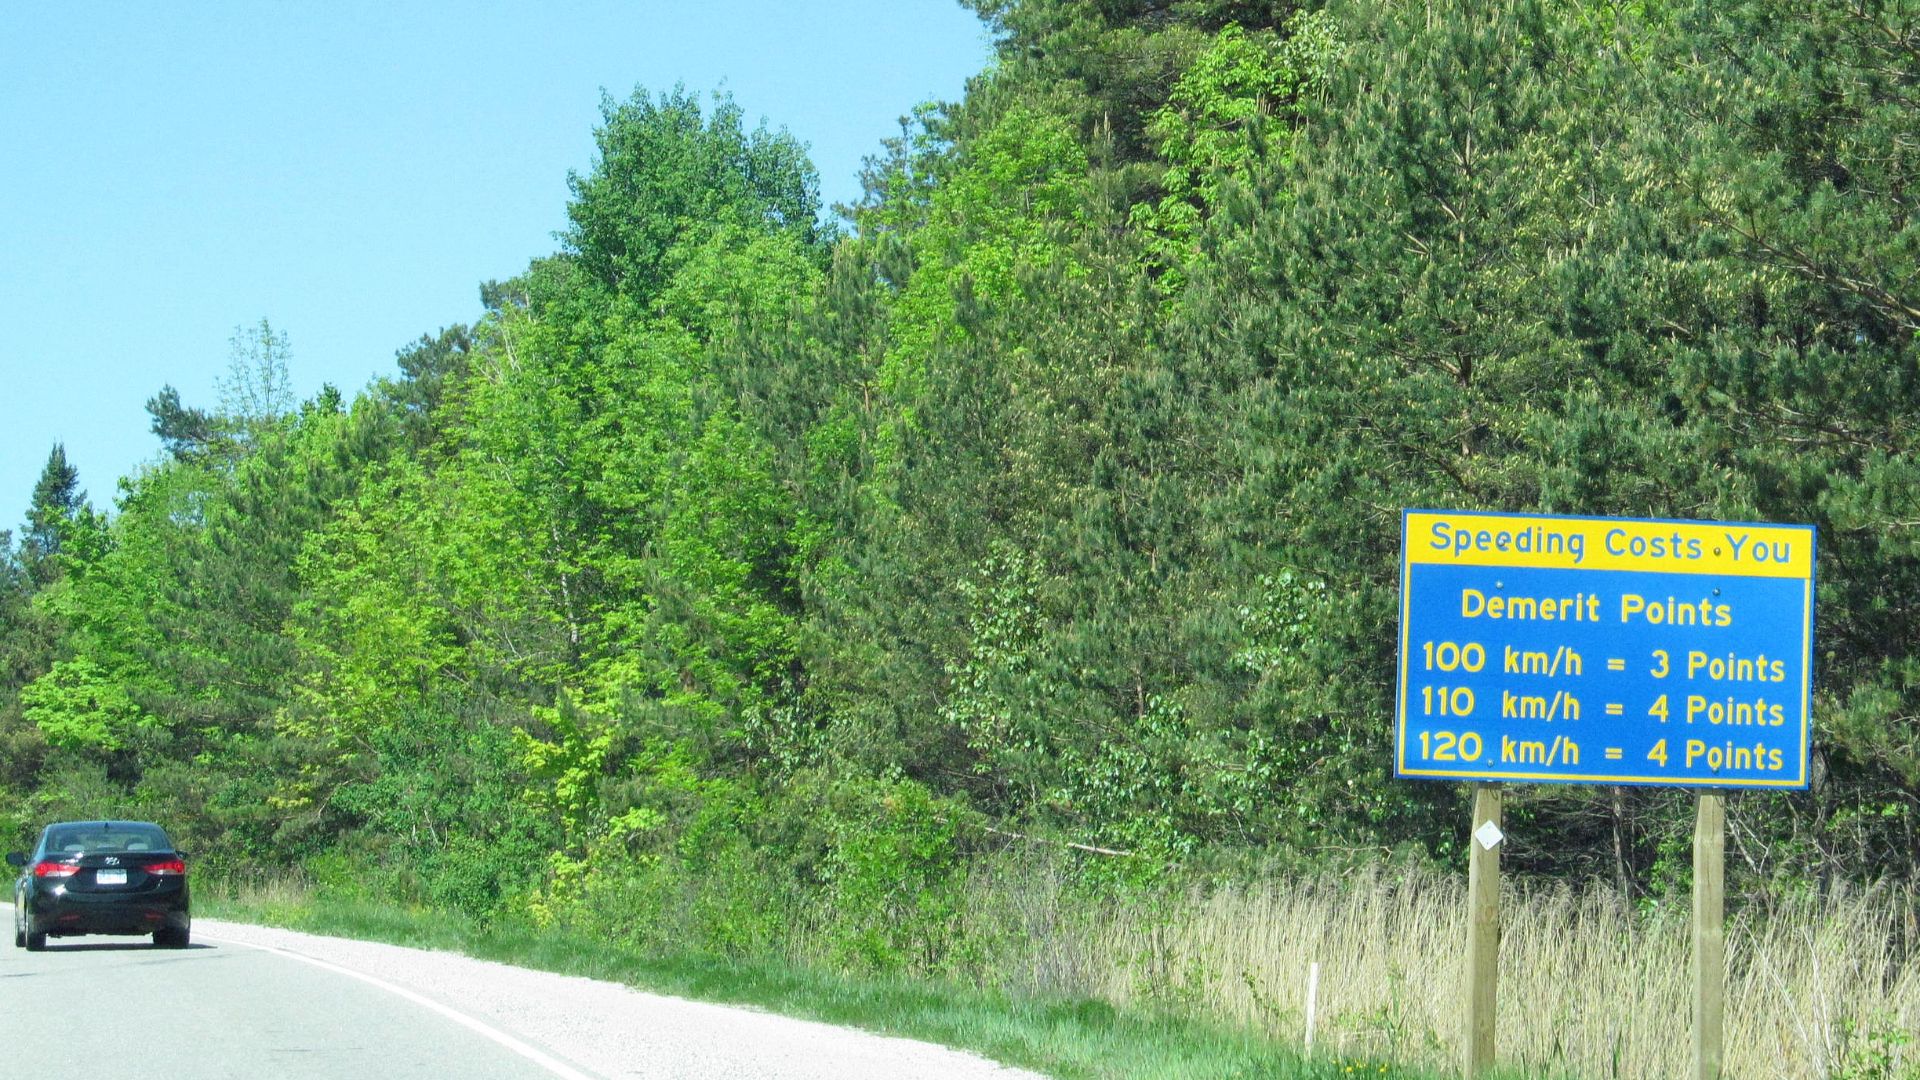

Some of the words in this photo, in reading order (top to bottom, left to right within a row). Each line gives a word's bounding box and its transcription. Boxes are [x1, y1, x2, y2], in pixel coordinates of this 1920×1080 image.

[1429, 522, 1585, 563] Speeding
[1605, 529, 1702, 559] Costs
[1725, 534, 1791, 564] You
[1462, 589, 1600, 622] Demerit
[1621, 594, 1732, 627] Points
[1422, 642, 1485, 672] 100
[1504, 645, 1582, 678] km/h
[1607, 658, 1625, 670] =
[1650, 650, 1669, 678] 3
[1688, 652, 1785, 682] Points
[1422, 686, 1475, 716] 110
[1502, 690, 1580, 722] km/h
[1605, 703, 1623, 716] =
[1648, 695, 1669, 723] 4
[1686, 696, 1785, 726] Points
[1419, 731, 1482, 761] 120
[1501, 736, 1579, 766] km/h
[1605, 748, 1623, 759] =
[1647, 739, 1667, 767] 4
[1685, 739, 1783, 770] Points
